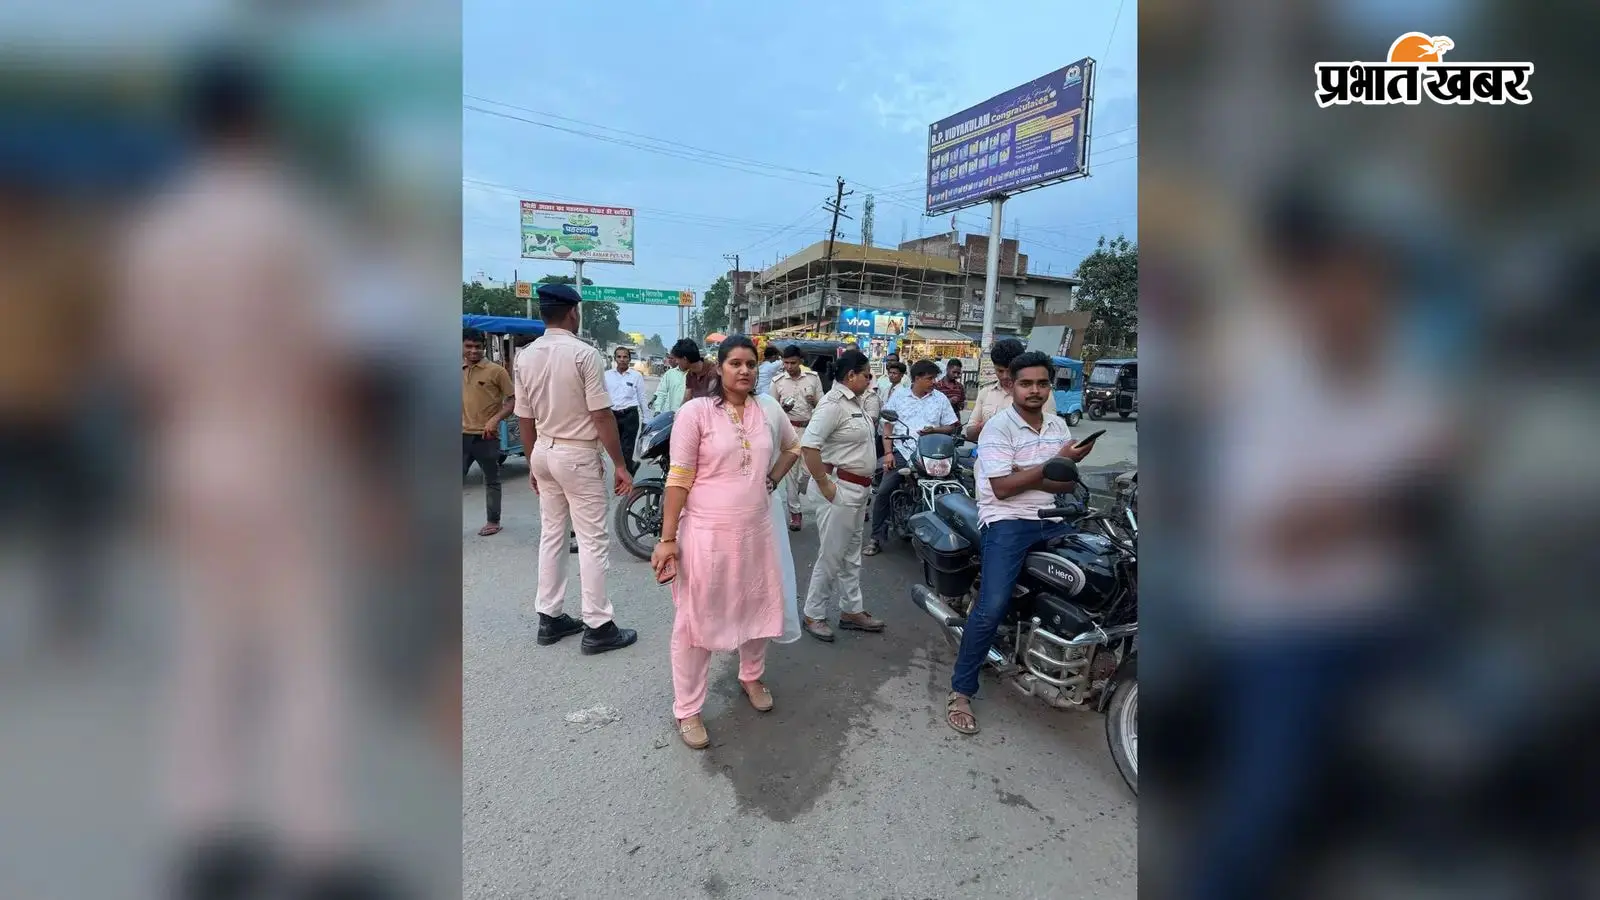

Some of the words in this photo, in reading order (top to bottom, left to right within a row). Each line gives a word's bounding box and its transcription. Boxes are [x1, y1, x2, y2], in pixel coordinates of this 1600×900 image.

[945, 113, 990, 140] VIDYAKULAM
[991, 94, 1049, 122] Congratulates
[565, 226, 597, 235] पहलवान
[846, 316, 871, 327] vivo
[1055, 568, 1074, 582] Hero
